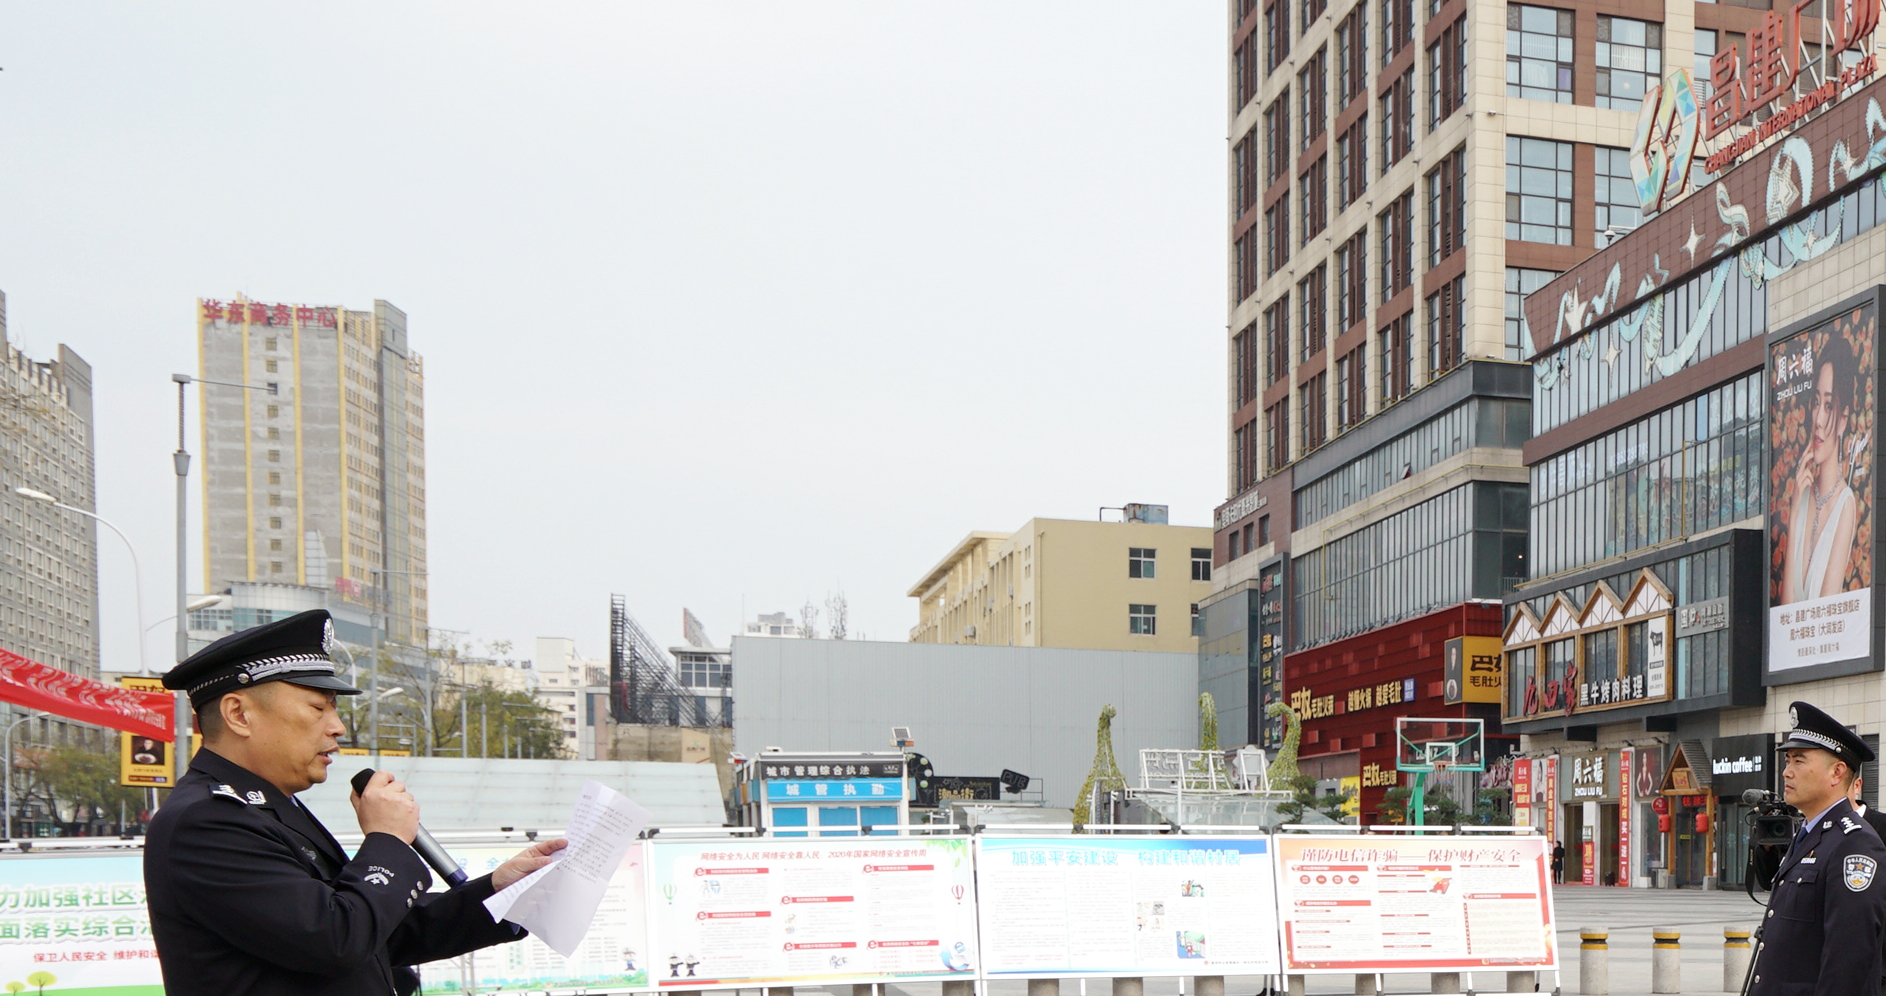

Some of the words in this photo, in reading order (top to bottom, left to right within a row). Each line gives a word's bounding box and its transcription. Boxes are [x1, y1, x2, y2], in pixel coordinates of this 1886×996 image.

[1758, 80, 1837, 142] INTERNATIONAL
[1839, 53, 1879, 92] PLAZA
[202, 298, 337, 328] 华东商务中心
[1776, 345, 1814, 386] 周六福
[1776, 389, 1793, 401] ZHOU
[1793, 384, 1803, 394] LIU
[1803, 380, 1812, 391] FU
[1579, 674, 1644, 707] 黑牛烤肉料理
[1572, 756, 1604, 785] 周六福
[1712, 757, 1732, 775] luckin
[1732, 756, 1753, 774] coffee
[785, 783, 886, 797] 城管执勤
[1003, 772, 1027, 790] PUB
[1574, 787, 1588, 797] ZHOU
[1587, 787, 1596, 796] LIU
[1596, 786, 1603, 796] FU
[1011, 849, 1119, 867] 加强平安建设
[367, 865, 395, 878] POLICE
[33, 951, 108, 963] 保卫人民安全
